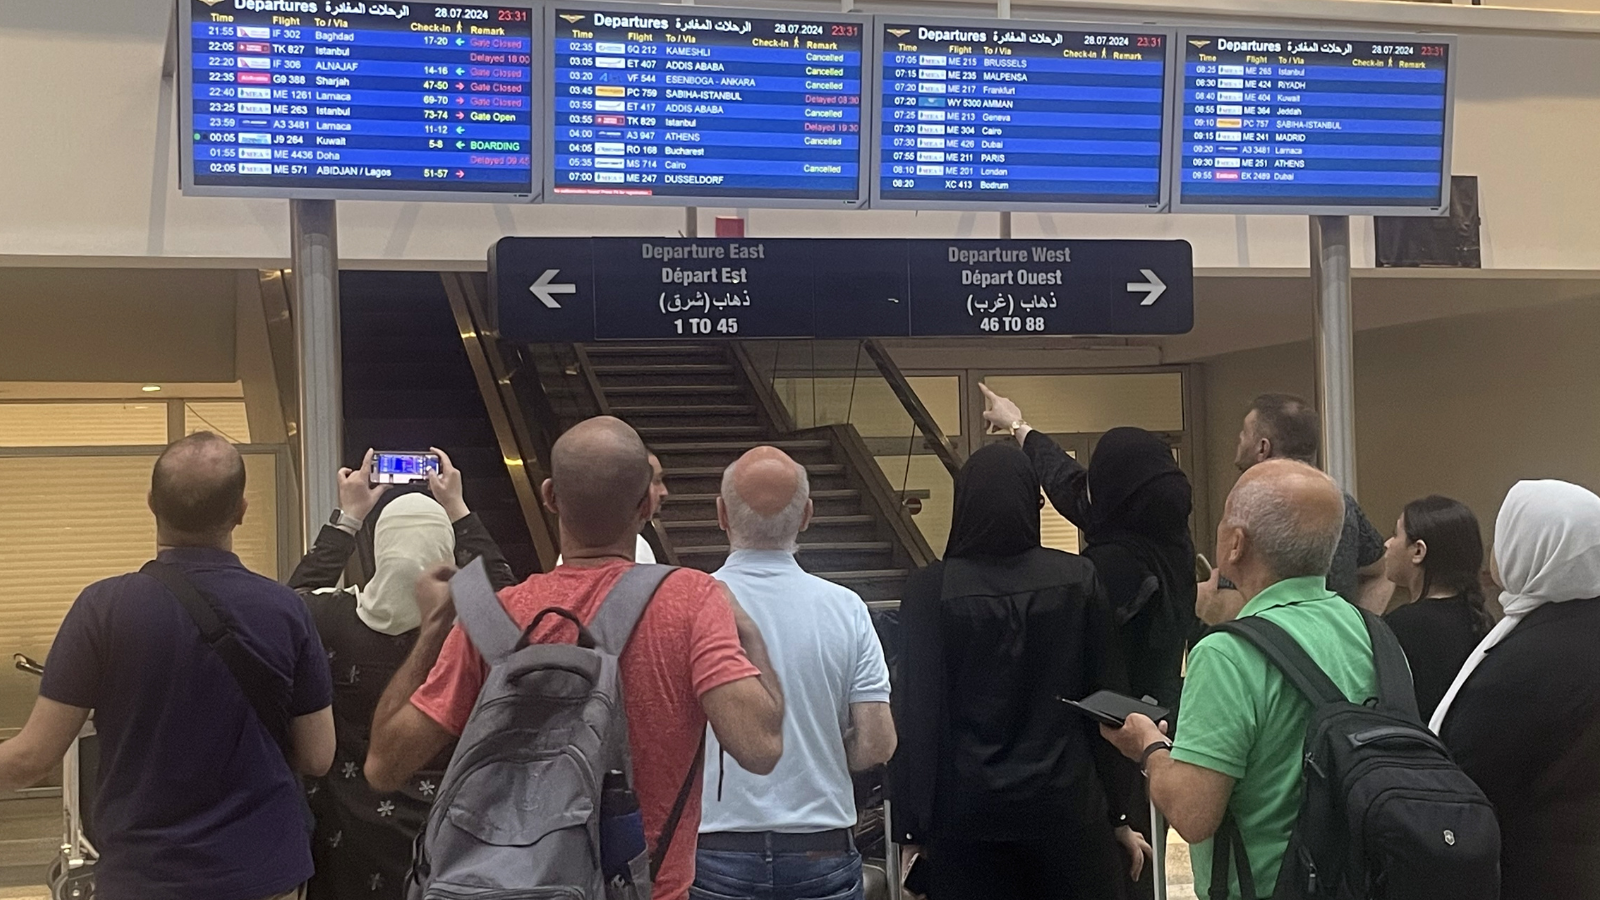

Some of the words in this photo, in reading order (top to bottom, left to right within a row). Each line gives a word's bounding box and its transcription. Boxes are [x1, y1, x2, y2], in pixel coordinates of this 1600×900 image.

[235, 0, 317, 12] Departures
[369, 4, 409, 18] الرحلات
[435, 8, 488, 19] 28.07.2024
[498, 10, 527, 21] 23:31
[594, 14, 668, 29] Departures
[211, 13, 234, 22] Time
[273, 16, 300, 26] Flight
[315, 18, 325, 26] To
[333, 19, 348, 27] Via
[471, 26, 505, 35] Remark
[715, 21, 751, 34] الرحلات
[775, 24, 823, 34] 28.07.2024
[832, 26, 858, 36] 23:31
[209, 27, 234, 35] 21:55
[284, 30, 300, 38] 302
[316, 31, 354, 42] Baghdad
[424, 37, 448, 45] 17-20
[572, 30, 593, 38] Time
[628, 32, 652, 42] Flight
[666, 34, 676, 42] To
[682, 35, 696, 43] Via
[807, 41, 837, 50] Remark
[919, 28, 986, 42] Departures
[1029, 34, 1062, 46] الرحلات
[1084, 36, 1128, 45] 28.07.2024
[1137, 38, 1160, 47] 23:31
[570, 42, 592, 51] 02:35
[666, 48, 710, 56] KAMESHLI
[806, 53, 843, 62] Cancelled
[898, 43, 917, 52] Time
[949, 46, 971, 55] Flight
[984, 47, 993, 55] To
[1113, 52, 1142, 60] Remark
[1218, 39, 1281, 52] Departures
[1321, 44, 1352, 55] الرحلات
[1372, 45, 1413, 54] 28.07.2024
[1422, 47, 1443, 55] 23:31
[209, 42, 234, 51] 22:05
[273, 45, 286, 53] TK
[288, 45, 304, 54] 827
[316, 47, 349, 56] Istanbul
[470, 53, 504, 64] Delayed
[209, 58, 234, 66] 22:20
[316, 62, 358, 71] ALNAJAF
[570, 57, 593, 65] 03:05
[628, 60, 639, 68] ET
[641, 60, 656, 68] 407
[666, 62, 692, 70] ADDIS
[695, 63, 724, 71] ABABA
[806, 67, 843, 76] Cancelled
[896, 56, 916, 64] 07:05
[984, 60, 1027, 68] BRUSSELS
[1199, 54, 1216, 62] Time
[1246, 55, 1267, 64] Flight
[1399, 61, 1426, 69] Remark
[209, 73, 234, 81] 22:35
[273, 75, 286, 84] G9
[316, 77, 349, 87] Sharjah
[423, 81, 448, 90] 47-50
[470, 83, 489, 92] Gate
[493, 83, 521, 92] Closed
[896, 70, 916, 78] 07:15
[984, 73, 1027, 81] MALPENSA
[209, 88, 234, 96] 22:40
[273, 90, 287, 98] ME
[570, 86, 592, 94] 03:45
[627, 89, 640, 97] PC
[666, 91, 742, 100] SABIHA-ISTANBUL
[666, 105, 692, 113] ADDIS
[695, 106, 723, 114] ABABA
[983, 100, 1013, 108] AMMAN
[210, 103, 235, 112] 23:25
[274, 105, 288, 113] ME
[317, 107, 350, 116] Istanbul
[424, 111, 448, 119] 73-74
[471, 112, 490, 120] Gate
[493, 113, 515, 122] Open
[1277, 108, 1301, 116] Jeddah
[210, 118, 235, 127] 23:59
[425, 126, 447, 134] 11-12
[666, 118, 696, 127] Istanbul
[569, 130, 592, 138] 04:00
[665, 133, 700, 141] ATHENS
[804, 137, 841, 145] Cancelled
[982, 127, 1002, 135] Cairo
[210, 133, 235, 142] 00:05
[274, 135, 284, 143] J9
[317, 137, 346, 145] Kuwait
[471, 141, 520, 150] BOARDING
[210, 149, 235, 157] 01:55
[274, 151, 288, 159] ME
[291, 151, 313, 159] 4436
[317, 152, 340, 160] Doha
[665, 148, 704, 156] Bucharest
[981, 154, 1005, 162] PARIS
[210, 164, 236, 172] 02:05
[274, 166, 288, 174] ME
[292, 166, 307, 174] 571
[317, 167, 358, 175] ABIDJAN
[365, 168, 391, 178] Lagos
[424, 169, 448, 178] 51-57
[1274, 160, 1304, 168] ATHENS
[981, 168, 1007, 176] London
[665, 176, 724, 185] DUSSELDORF
[945, 180, 957, 188] XC
[643, 243, 724, 261] Departure
[730, 244, 765, 259] East
[949, 247, 1027, 265] Departure
[1032, 248, 1071, 262] West
[662, 267, 718, 286] Départ
[722, 269, 746, 283] Est
[962, 269, 1013, 288] Départ
[1018, 270, 1062, 284] Ouest
[659, 292, 710, 314] (شرق)
[713, 289, 750, 308] ذهاب
[967, 294, 1014, 315] (غرب)
[1021, 292, 1057, 309] ذهاب
[675, 319, 682, 334] 1
[690, 318, 711, 333] TO
[717, 319, 737, 333] 45
[981, 317, 999, 331] 46
[1004, 317, 1021, 331] TO
[1026, 317, 1044, 331] 88
